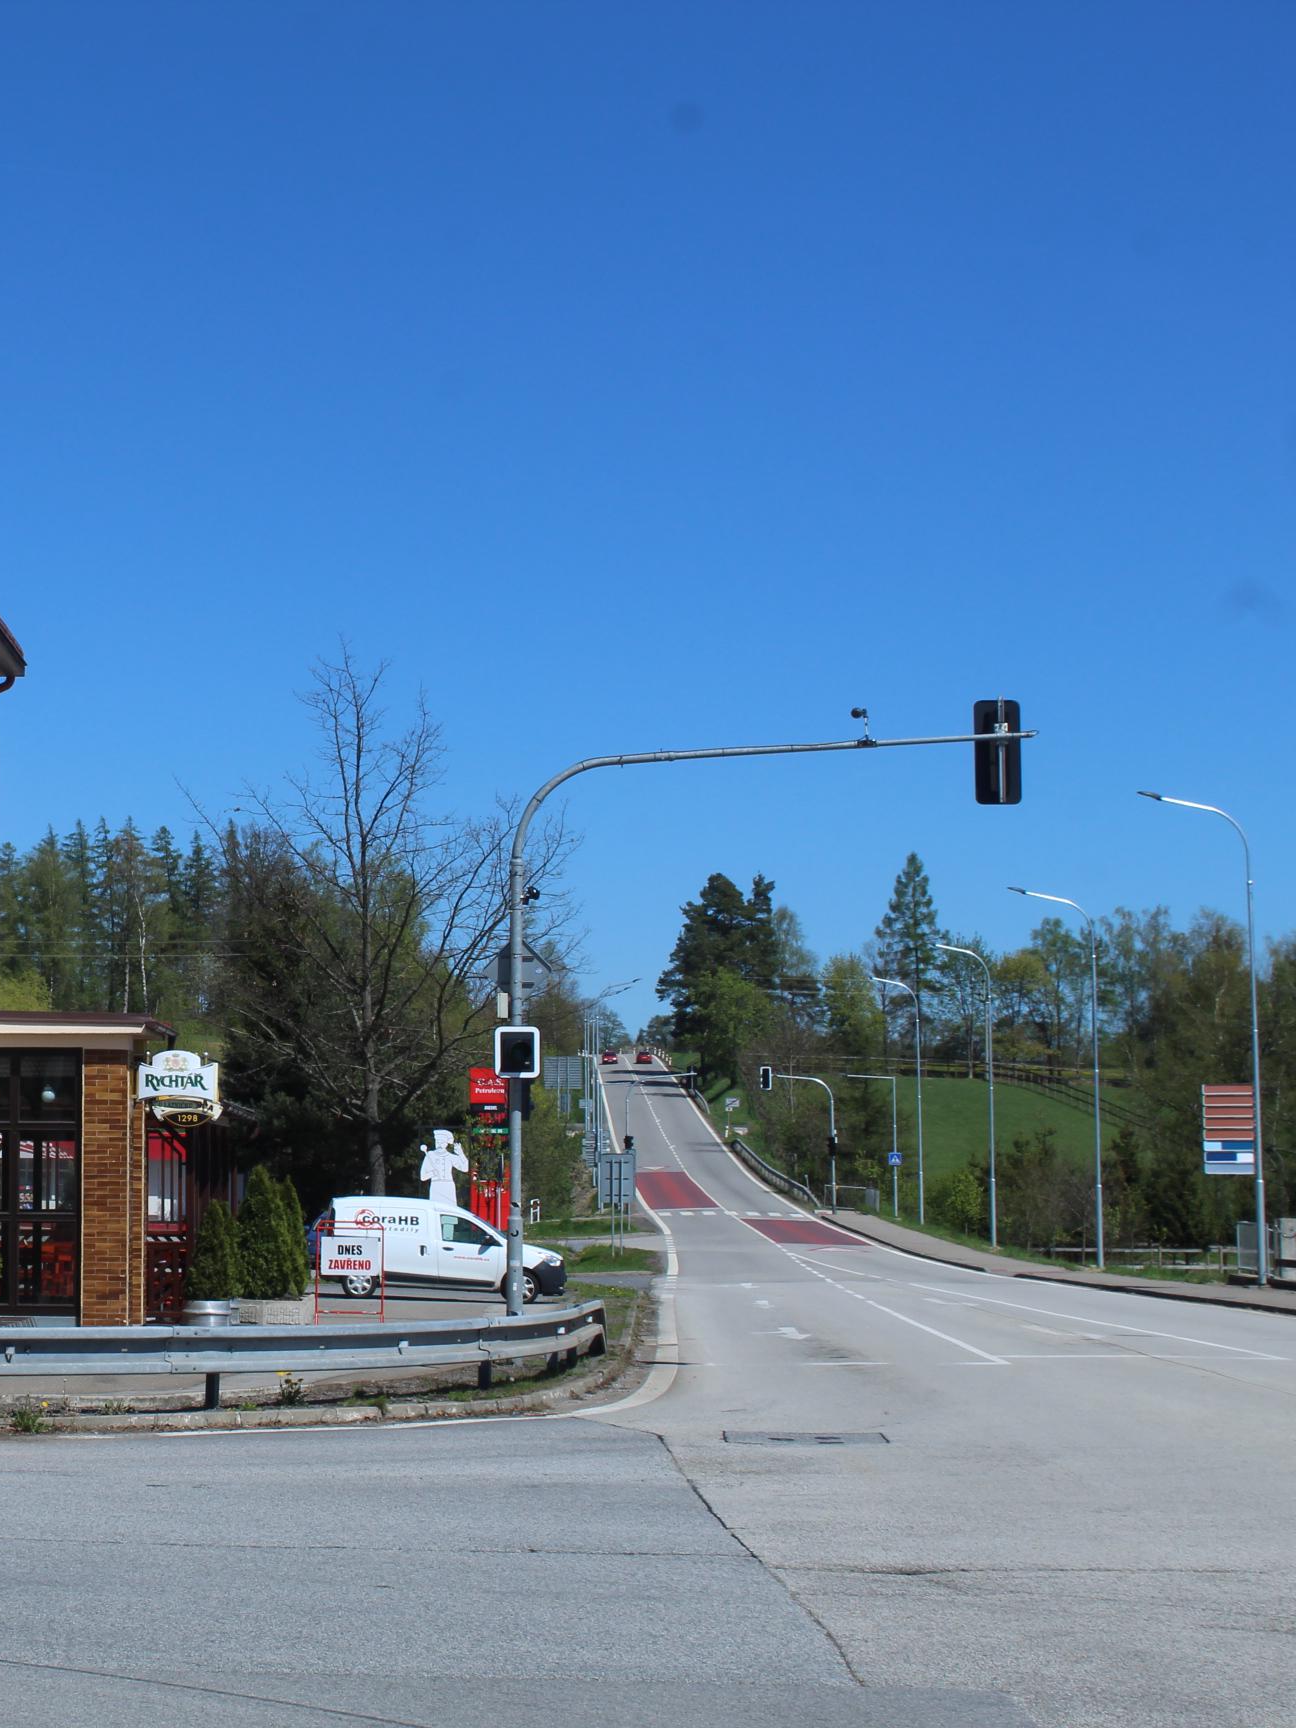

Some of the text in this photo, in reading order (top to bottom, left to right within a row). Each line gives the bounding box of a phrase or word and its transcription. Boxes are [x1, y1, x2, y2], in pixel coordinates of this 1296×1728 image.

[145, 1073, 208, 1090] RYCHTÁŘ
[177, 1113, 198, 1123] 1298
[337, 1244, 363, 1256] DNES
[328, 1257, 372, 1271] ZAVŘENO
